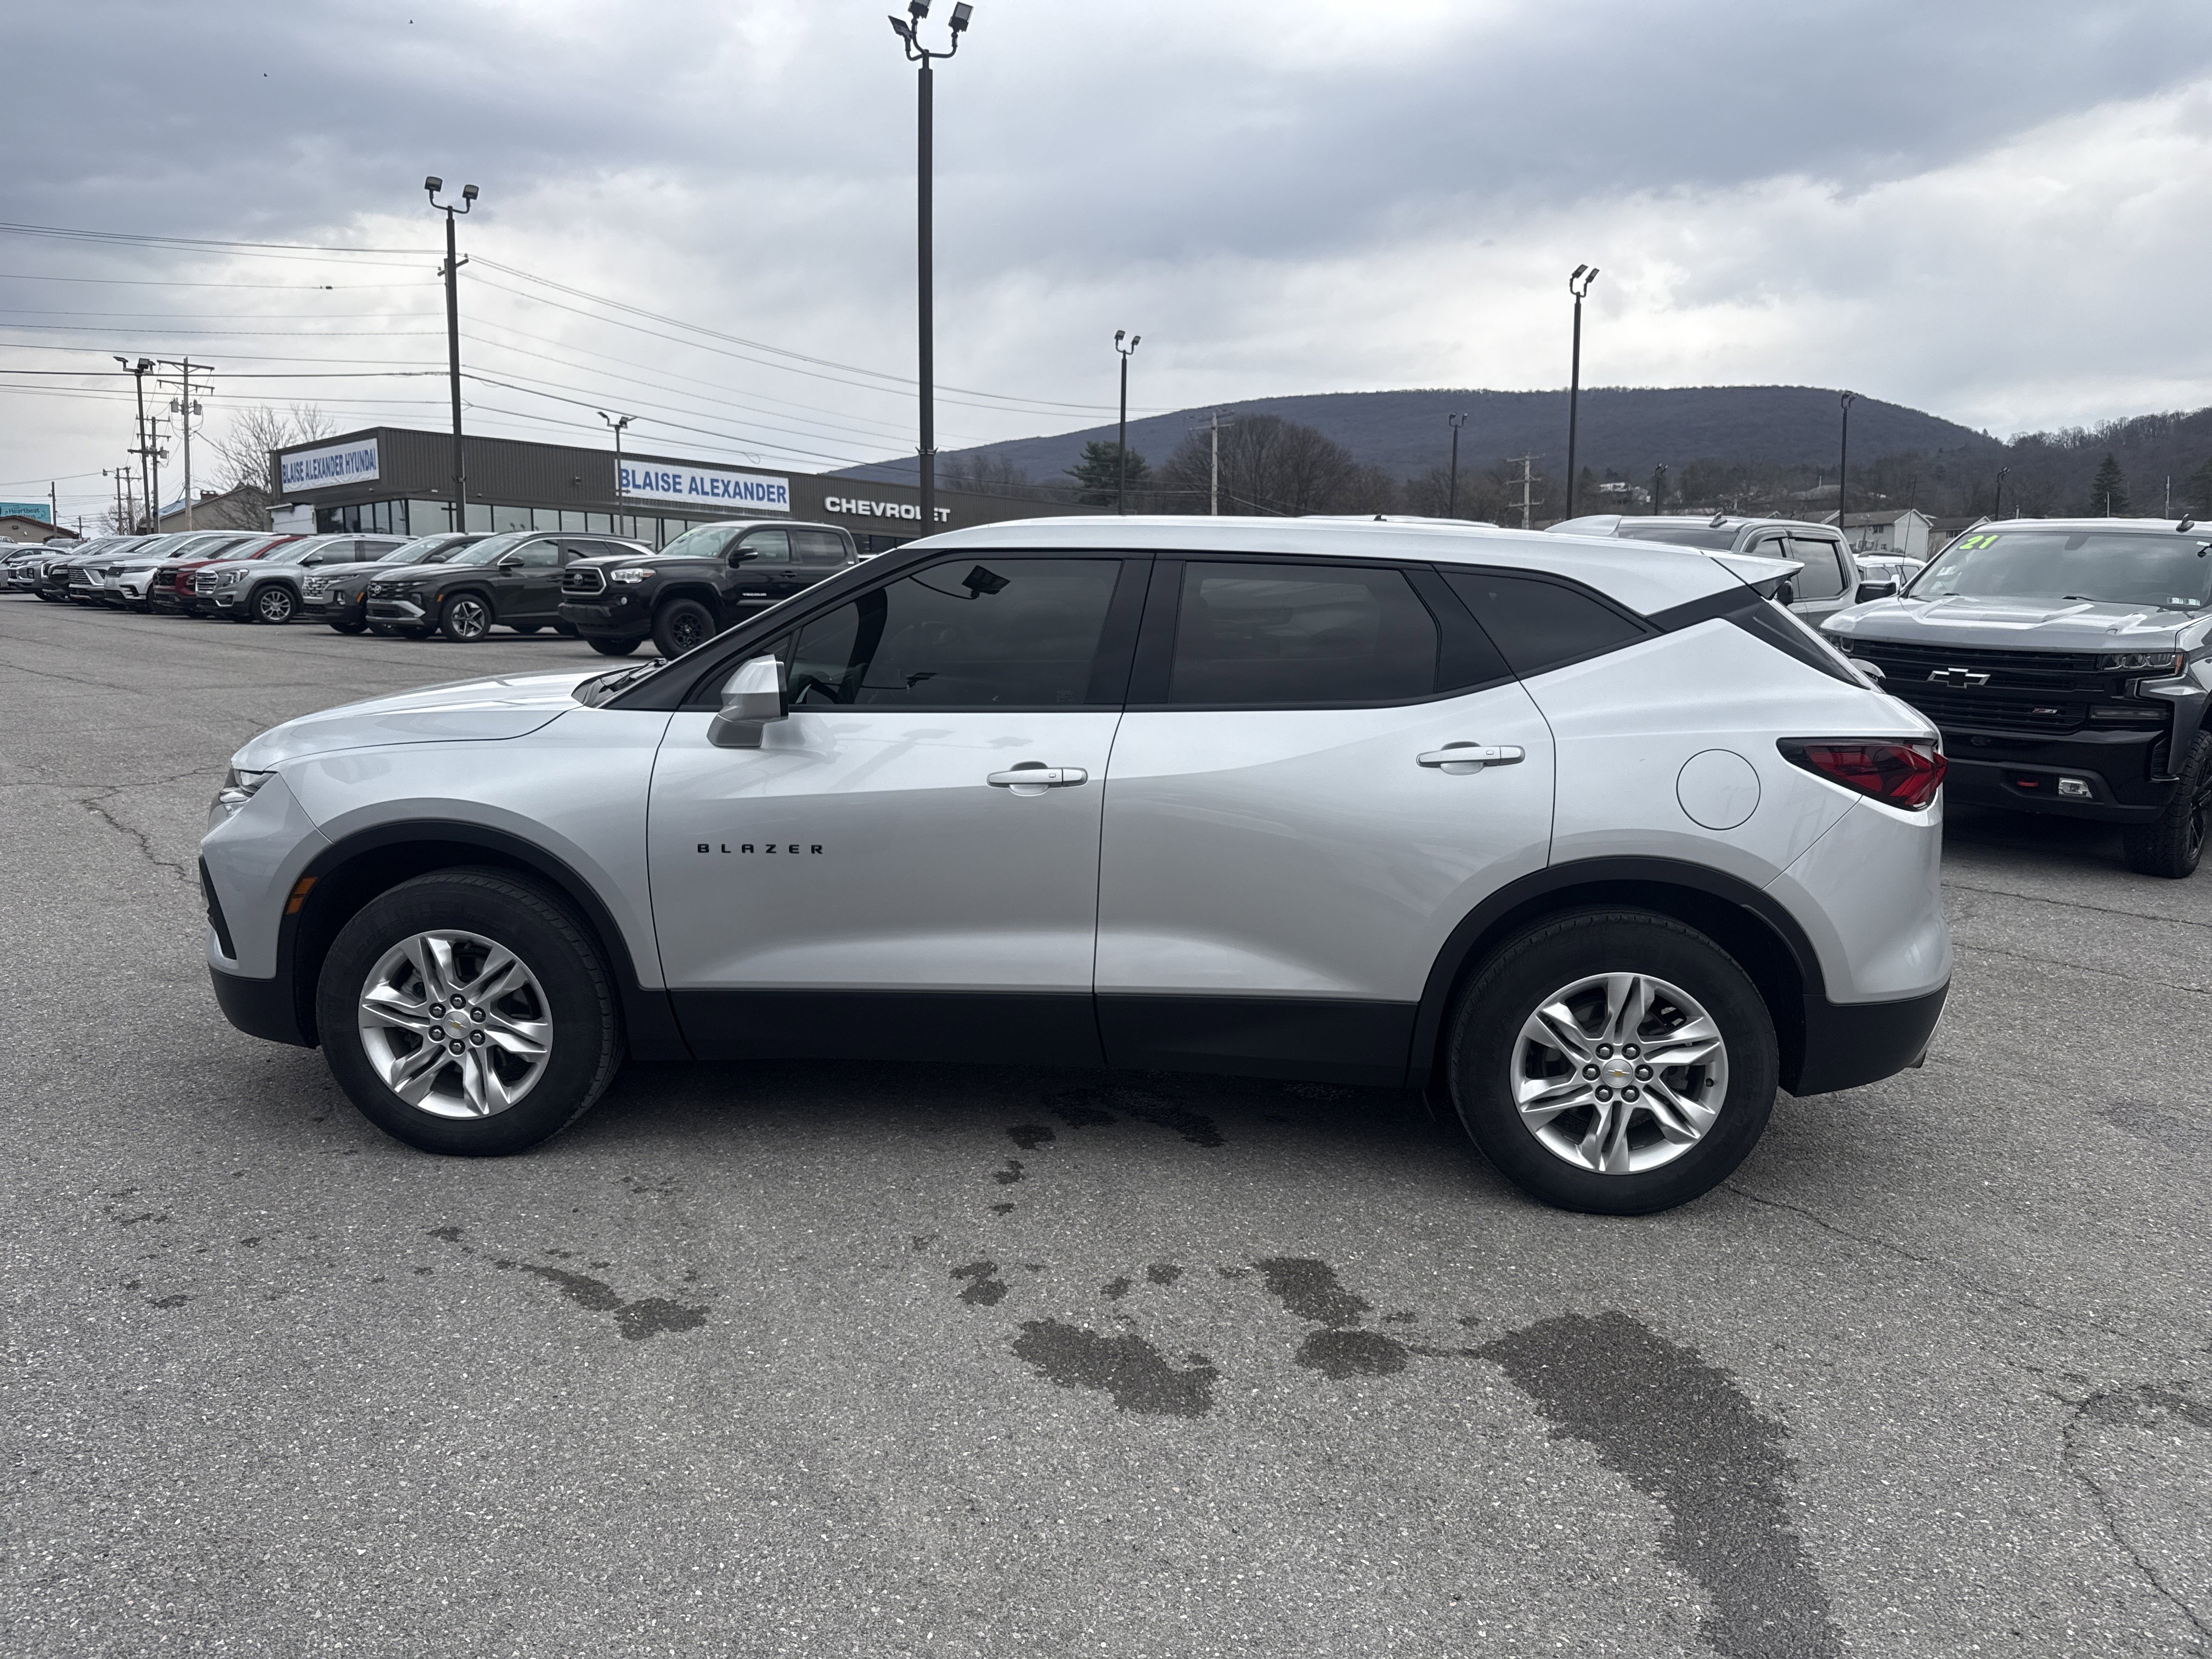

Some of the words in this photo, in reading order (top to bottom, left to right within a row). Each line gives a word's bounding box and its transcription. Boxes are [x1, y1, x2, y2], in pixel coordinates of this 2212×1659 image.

[282, 461, 304, 484] BLAISE
[306, 454, 344, 481] ALEXANDER
[345, 448, 376, 475] HYUNDAI
[620, 469, 683, 493] BLAISE
[688, 476, 788, 504] ALEXANDER
[1959, 535, 1999, 550] 21
[697, 843, 823, 854] BLAZER
